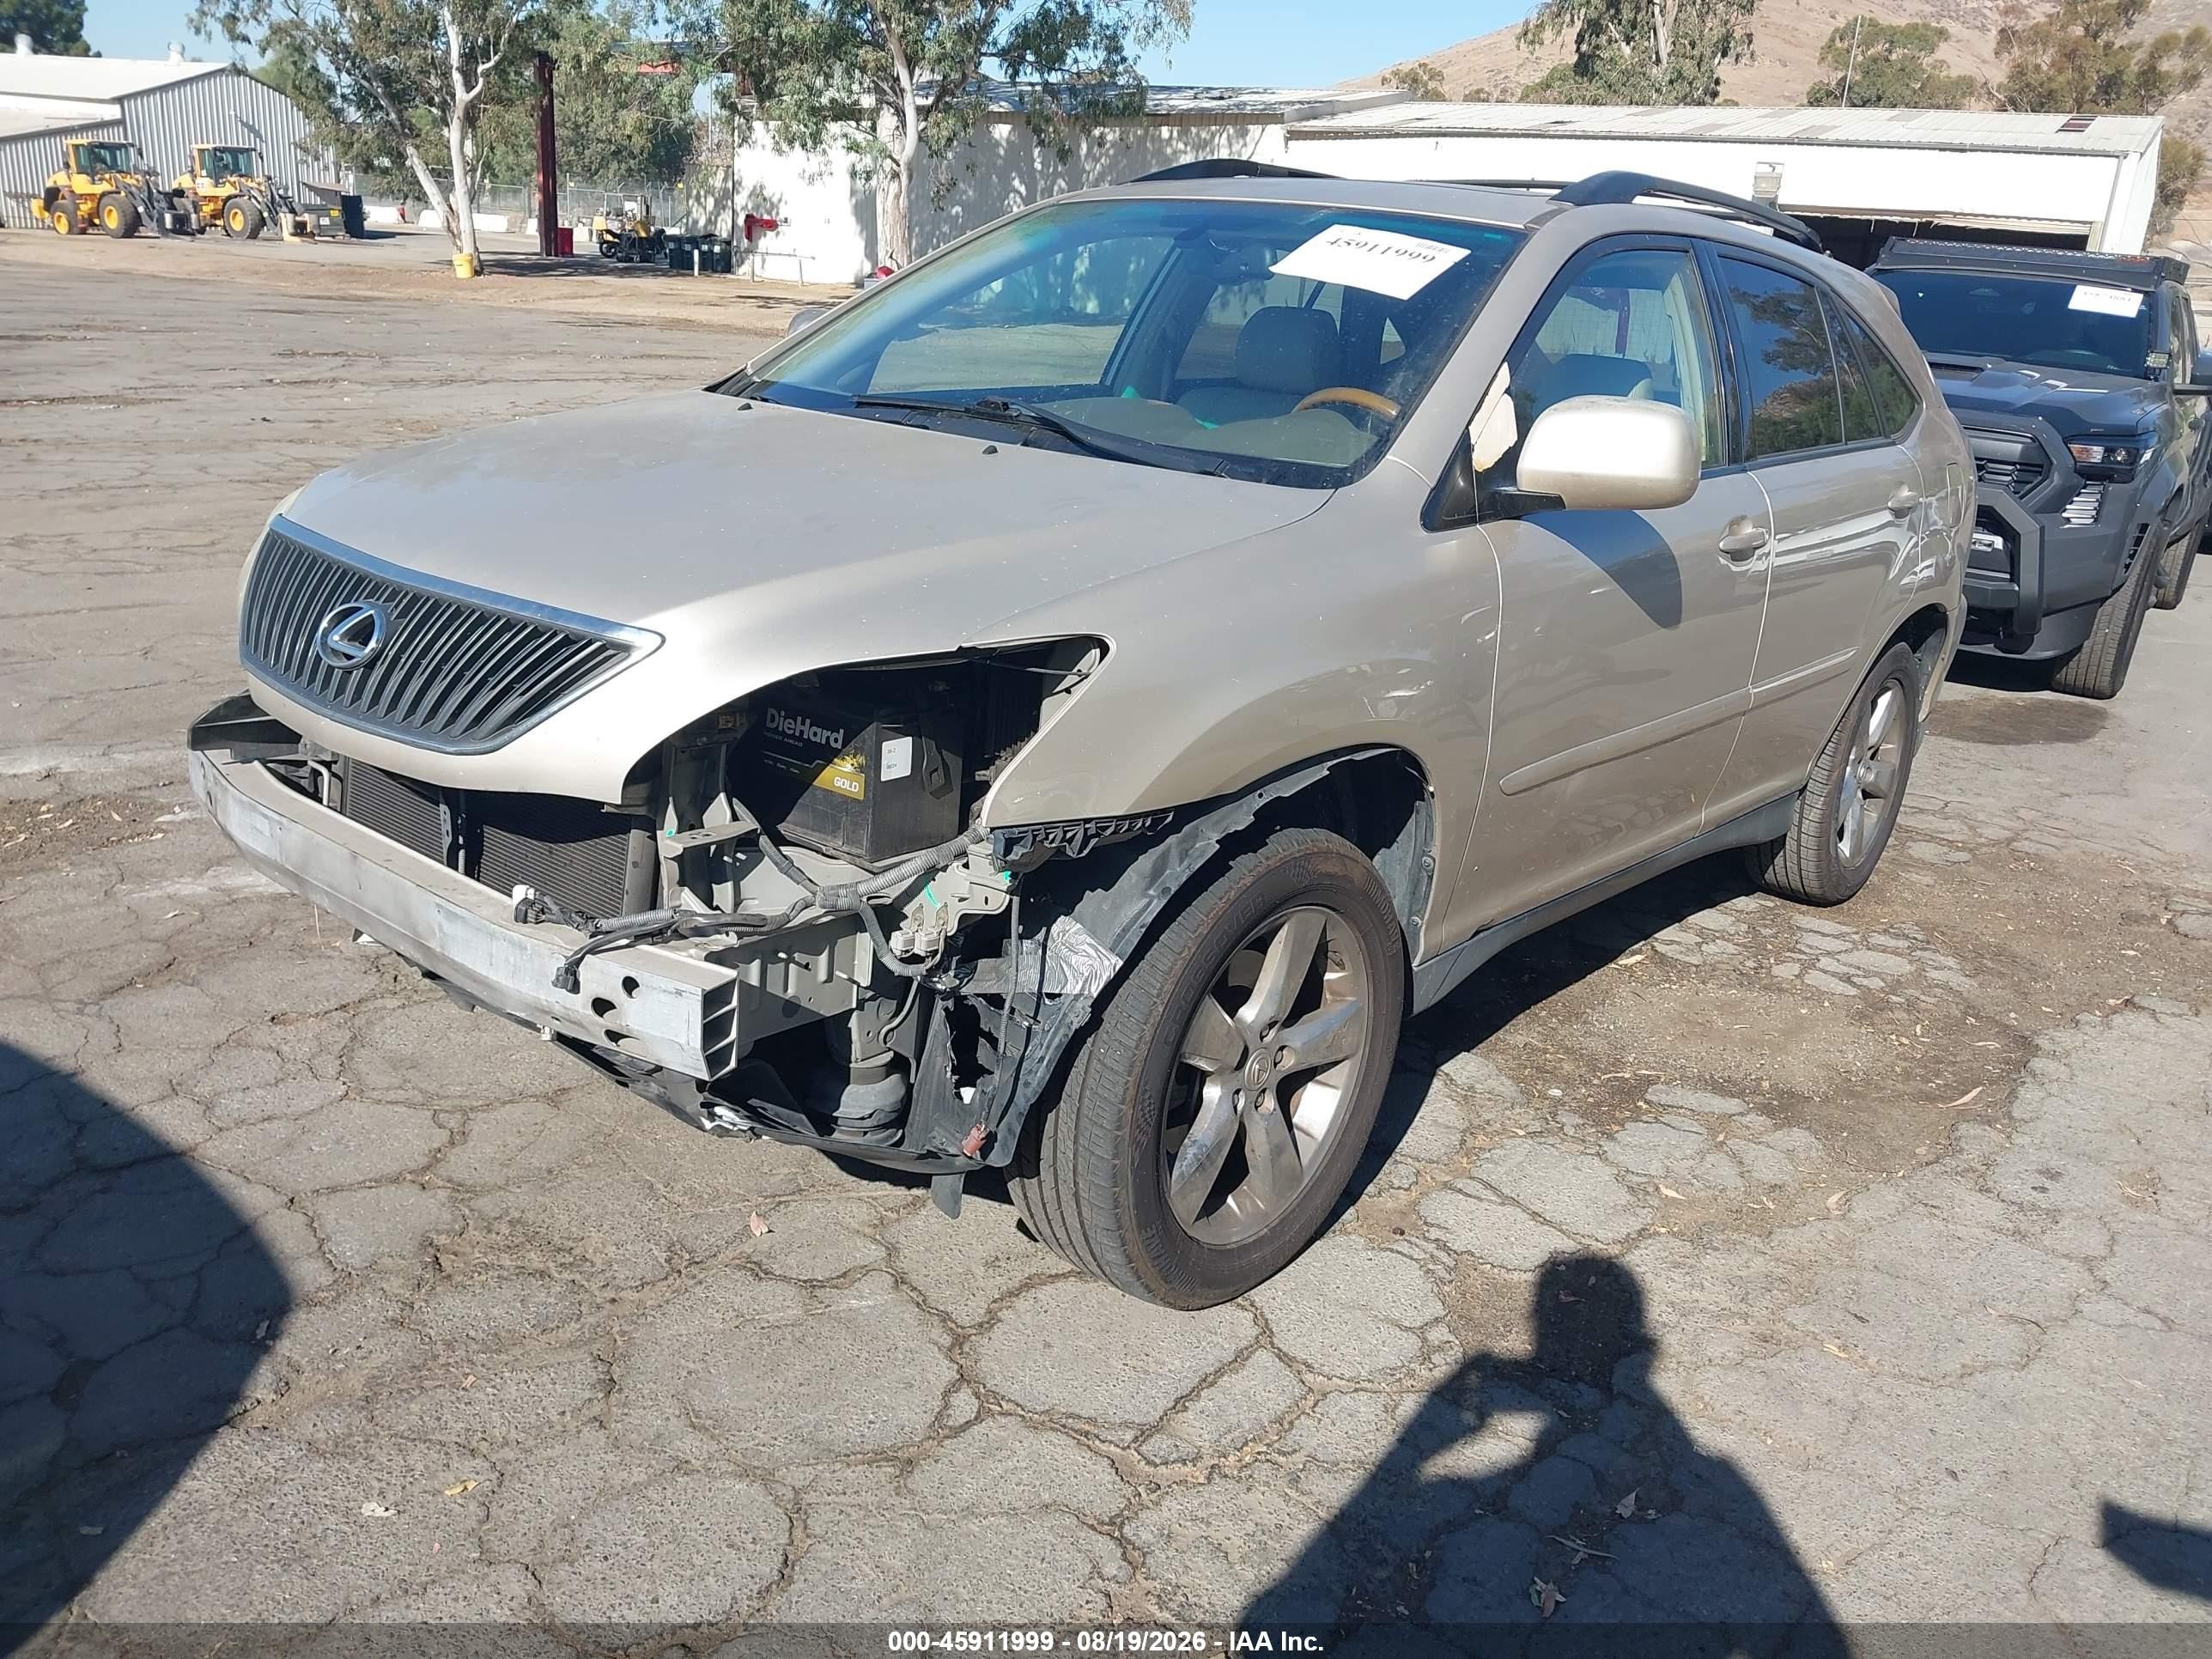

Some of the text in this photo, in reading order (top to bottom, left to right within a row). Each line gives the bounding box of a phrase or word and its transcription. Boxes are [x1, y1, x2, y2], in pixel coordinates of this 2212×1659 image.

[1326, 237, 1436, 264] 45911999
[765, 707, 844, 749] DieHard
[834, 776, 860, 793] GOLD
